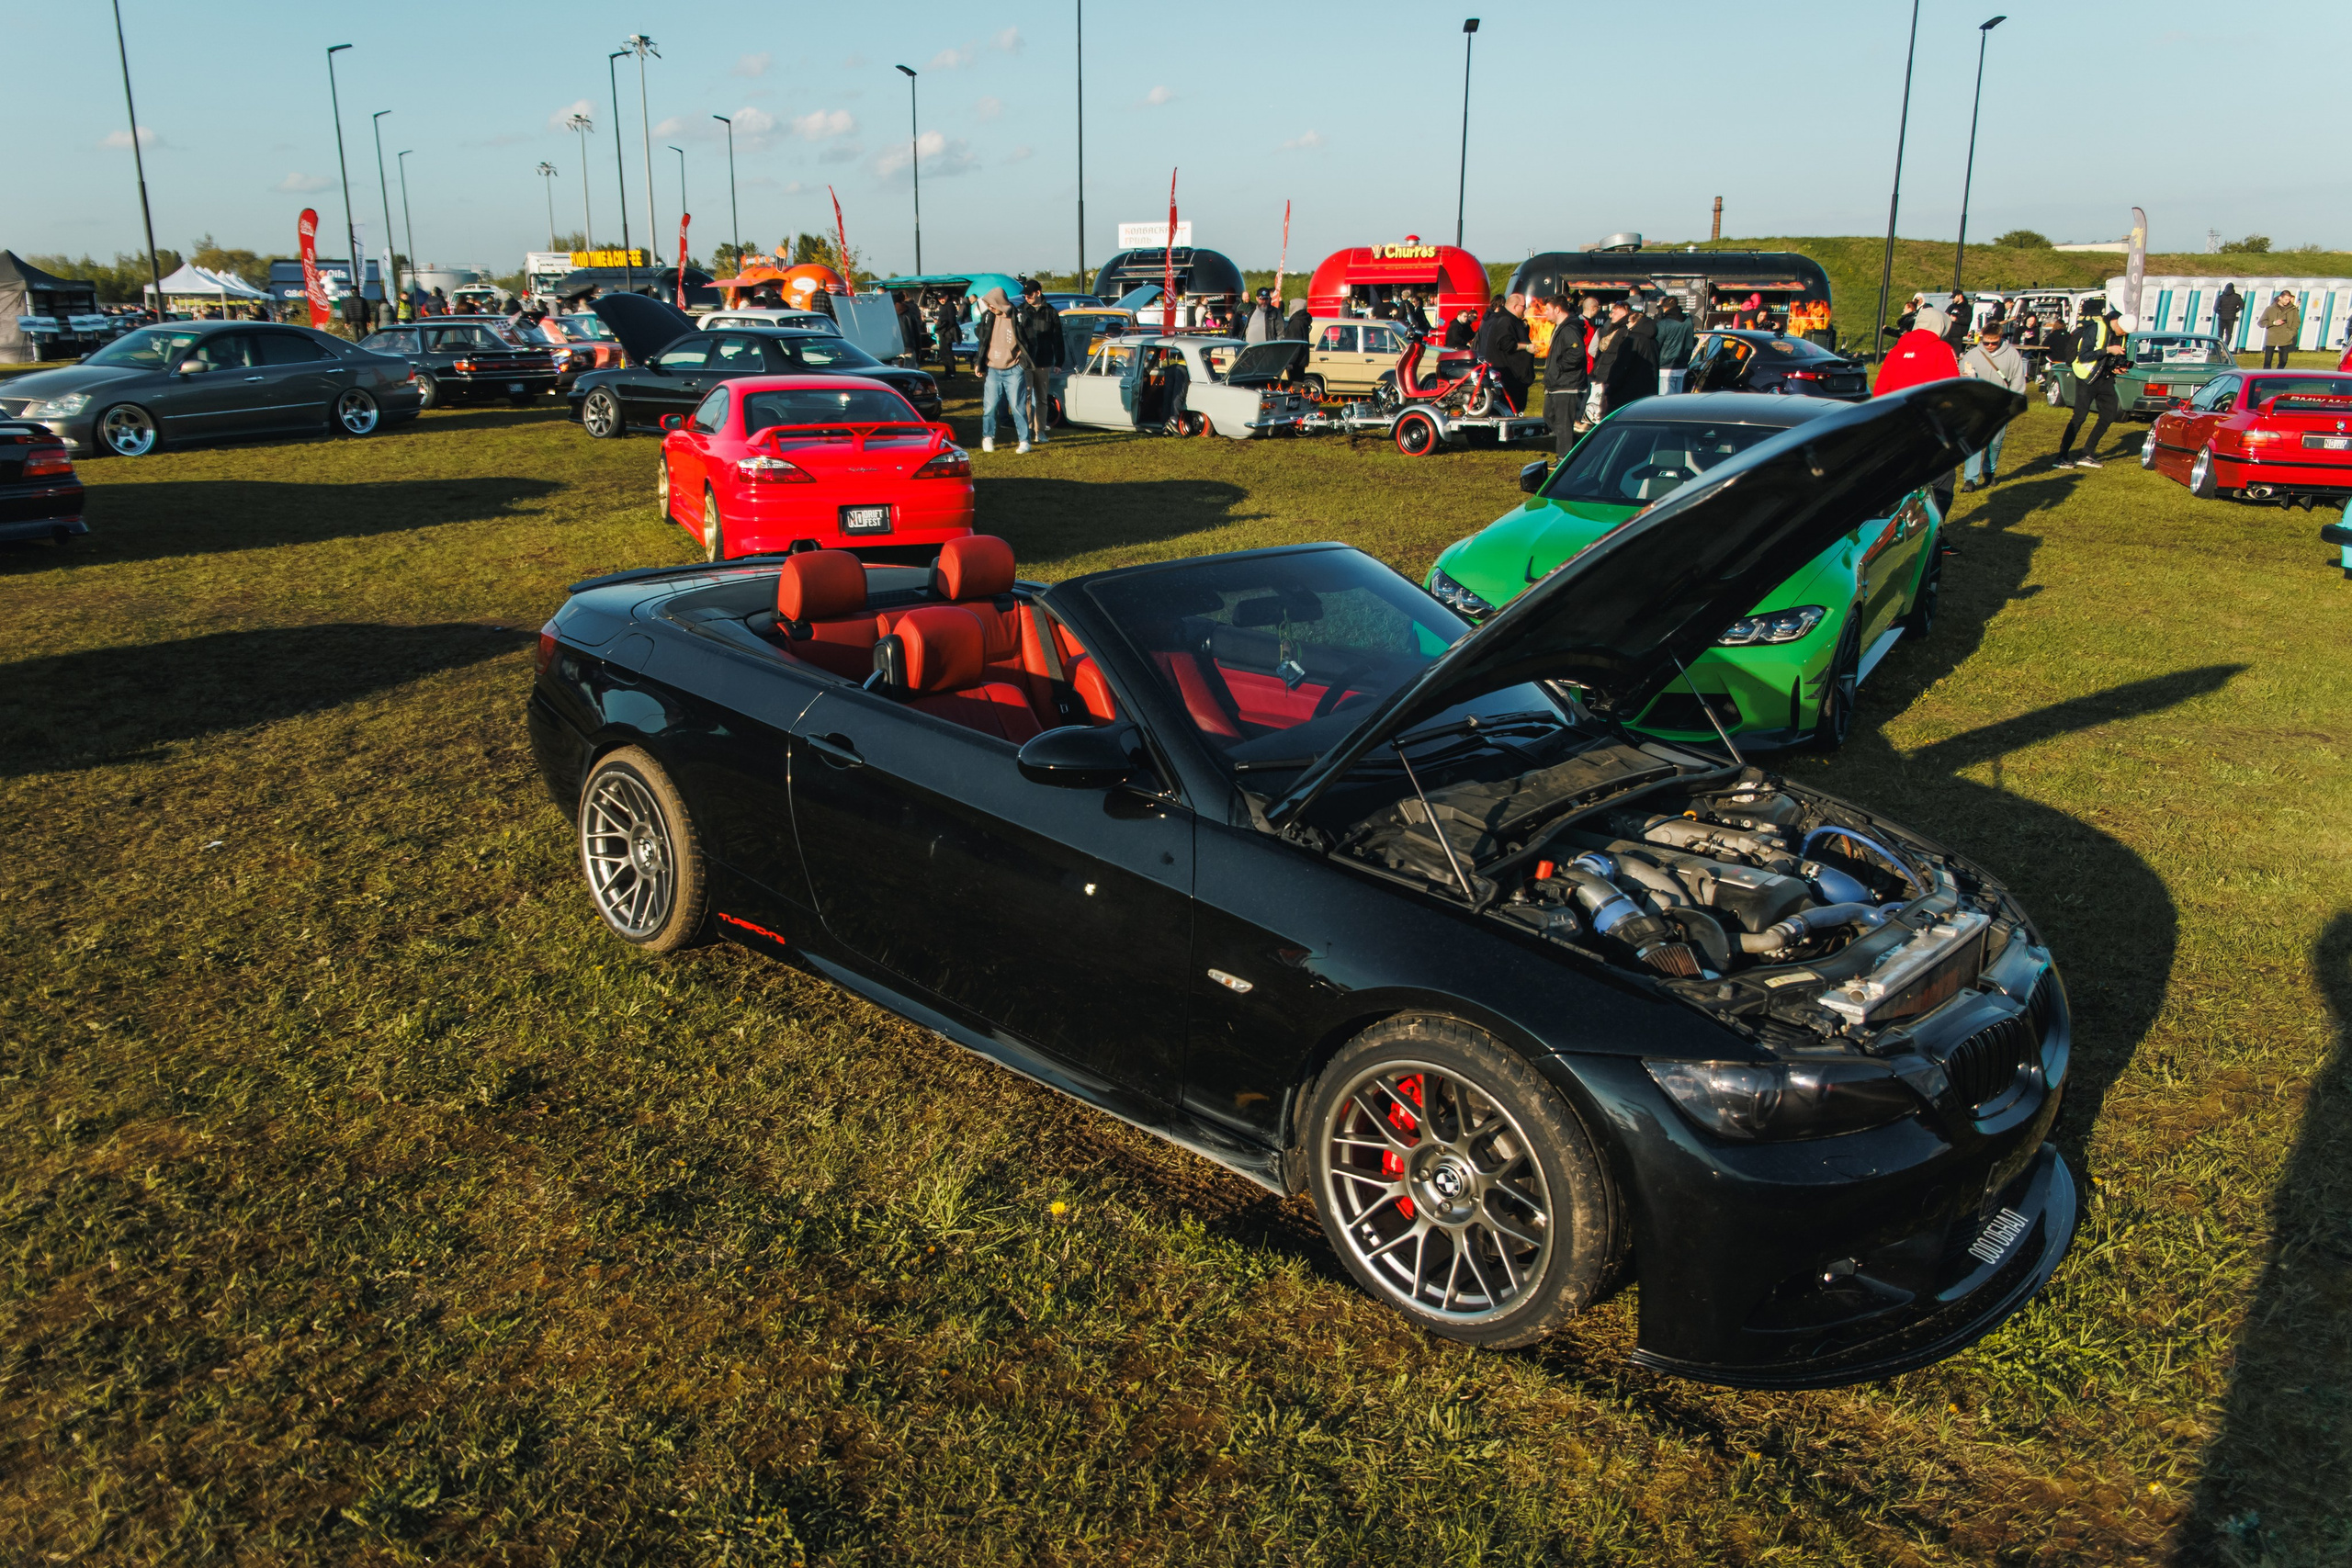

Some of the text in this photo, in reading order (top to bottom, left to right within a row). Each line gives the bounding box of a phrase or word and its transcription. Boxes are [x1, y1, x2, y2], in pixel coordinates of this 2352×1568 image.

[1385, 243, 1436, 258] Churros
[865, 509, 883, 519] DRIFT
[864, 518, 881, 527] FEST
